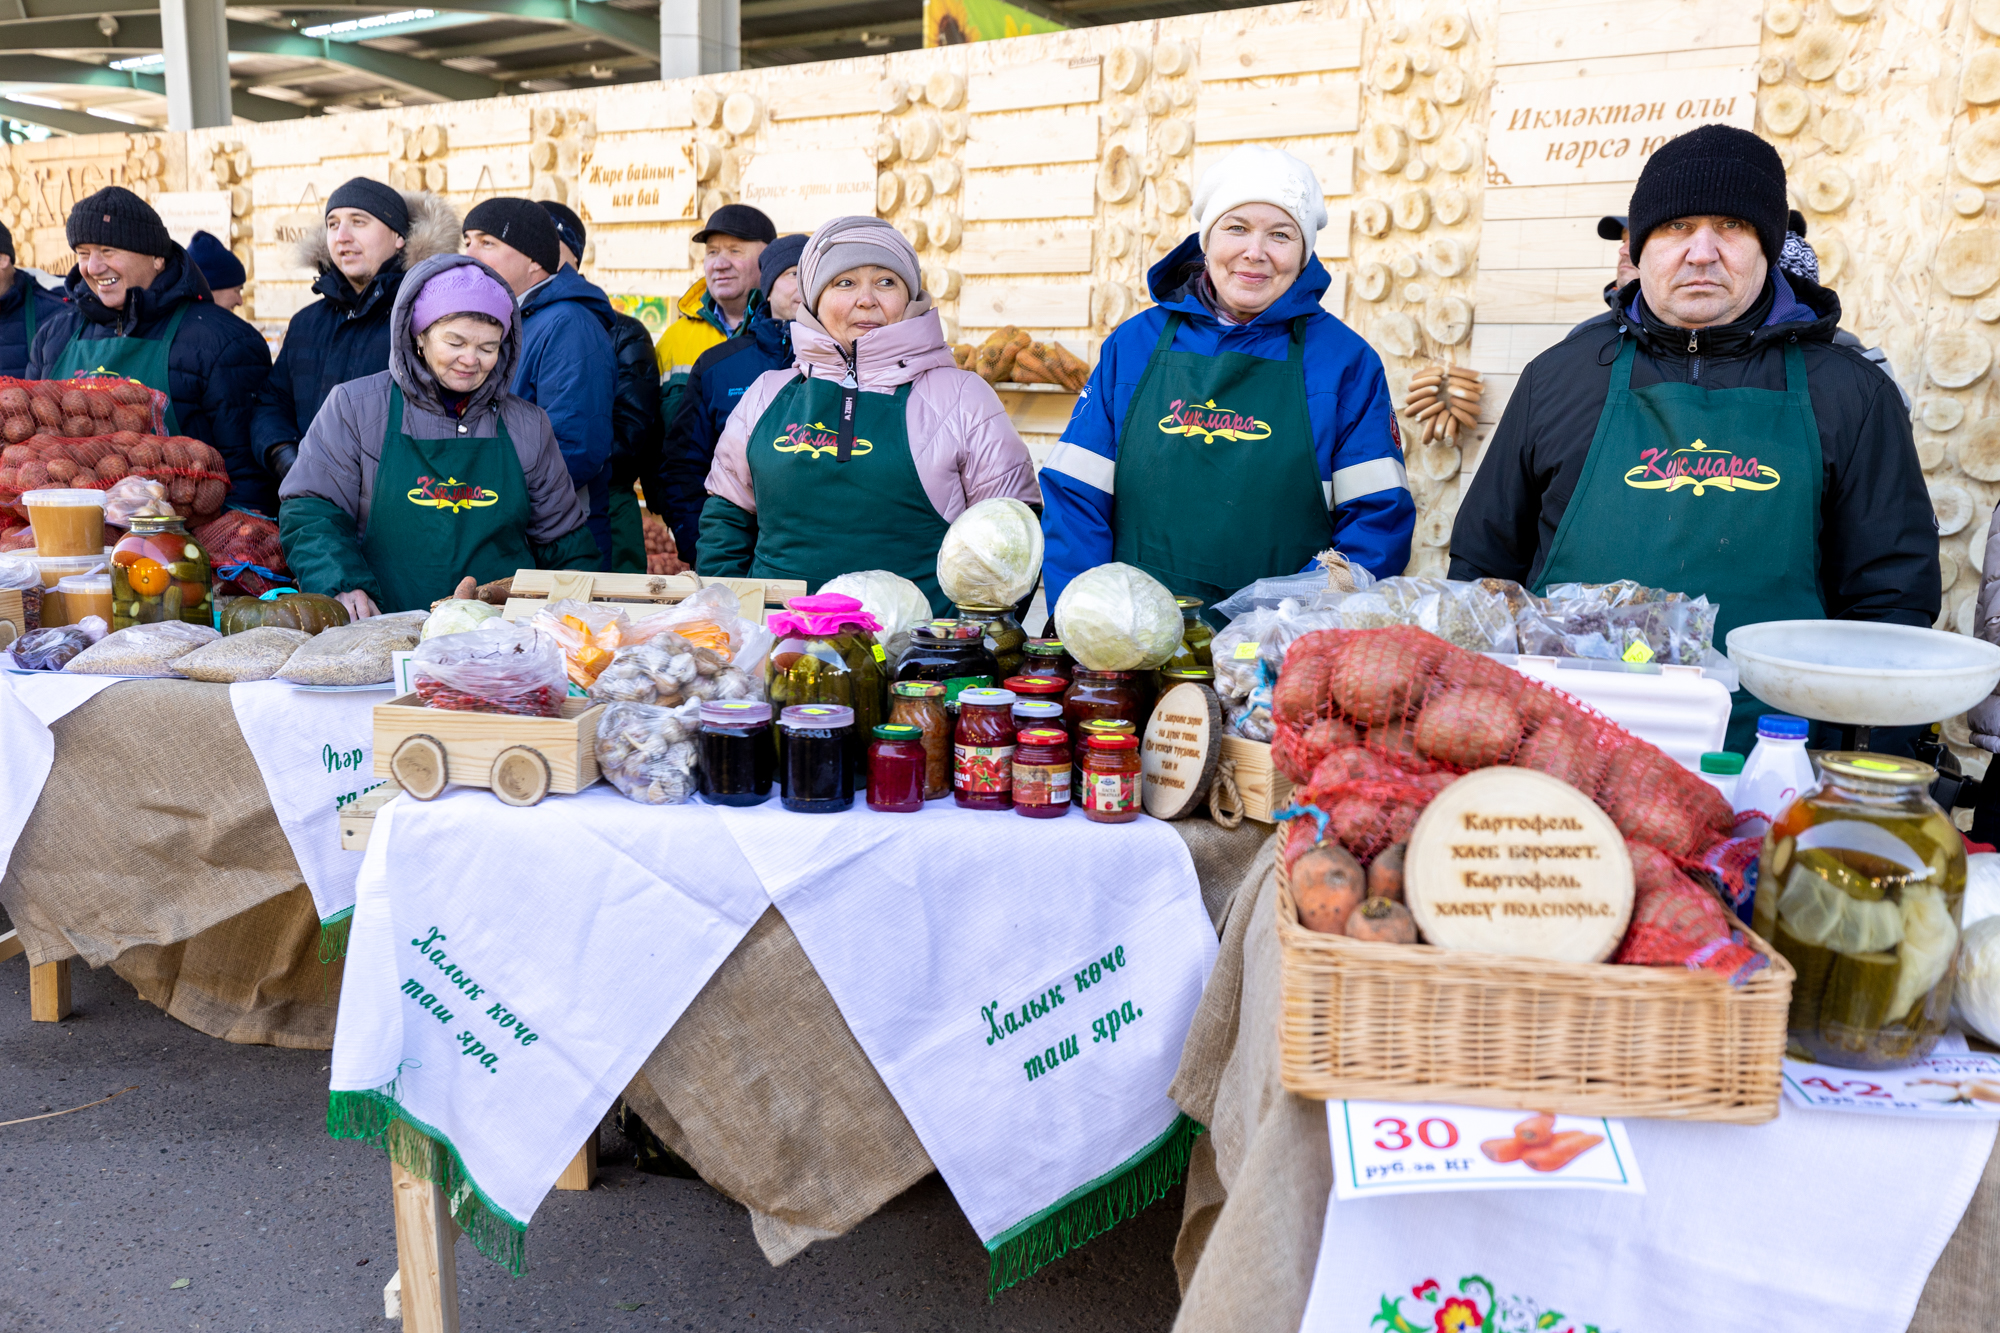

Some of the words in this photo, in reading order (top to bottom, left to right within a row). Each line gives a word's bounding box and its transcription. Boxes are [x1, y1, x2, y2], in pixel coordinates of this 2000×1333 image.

[1506, 101, 1667, 131] Икмәктән
[1675, 96, 1738, 120] олы
[1545, 136, 1631, 169] нәрсә
[588, 165, 624, 188] Жире
[798, 183, 832, 201] ярты
[612, 192, 634, 207] иле
[637, 188, 660, 206] бай
[1169, 398, 1256, 437] Кукмара
[1640, 447, 1761, 490] Кукмара
[1463, 812, 1585, 836] Картофель
[1463, 870, 1583, 894] Картофель
[411, 926, 485, 1001] Халык
[485, 1002, 539, 1046] көче
[981, 984, 1065, 1046] Халык
[1073, 944, 1126, 993] көче
[400, 978, 454, 1024] таш
[456, 1030, 500, 1074] яра.
[1023, 1033, 1080, 1082] таш
[1092, 1000, 1143, 1043] яра.
[1801, 1076, 1894, 1099] 42
[1374, 1117, 1459, 1151] 30
